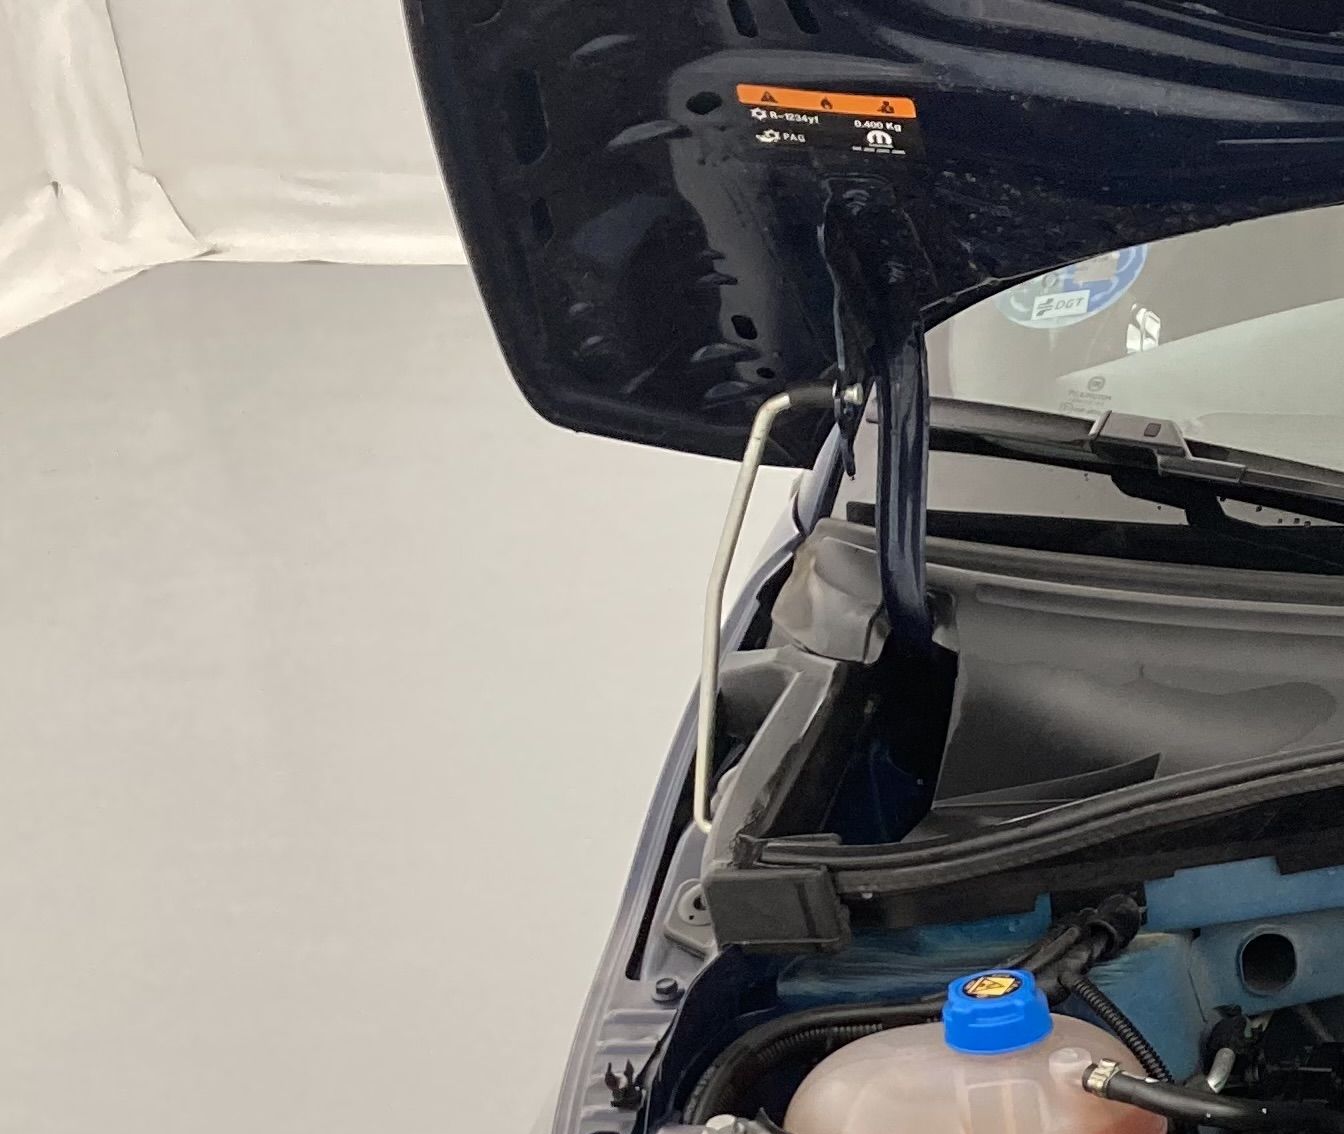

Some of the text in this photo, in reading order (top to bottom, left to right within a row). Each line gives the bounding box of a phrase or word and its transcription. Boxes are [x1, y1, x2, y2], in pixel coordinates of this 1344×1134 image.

[769, 112, 819, 124] R-1234yf
[885, 122, 902, 132] Kg
[783, 132, 806, 143] PAG
[1055, 296, 1085, 310] DGT
